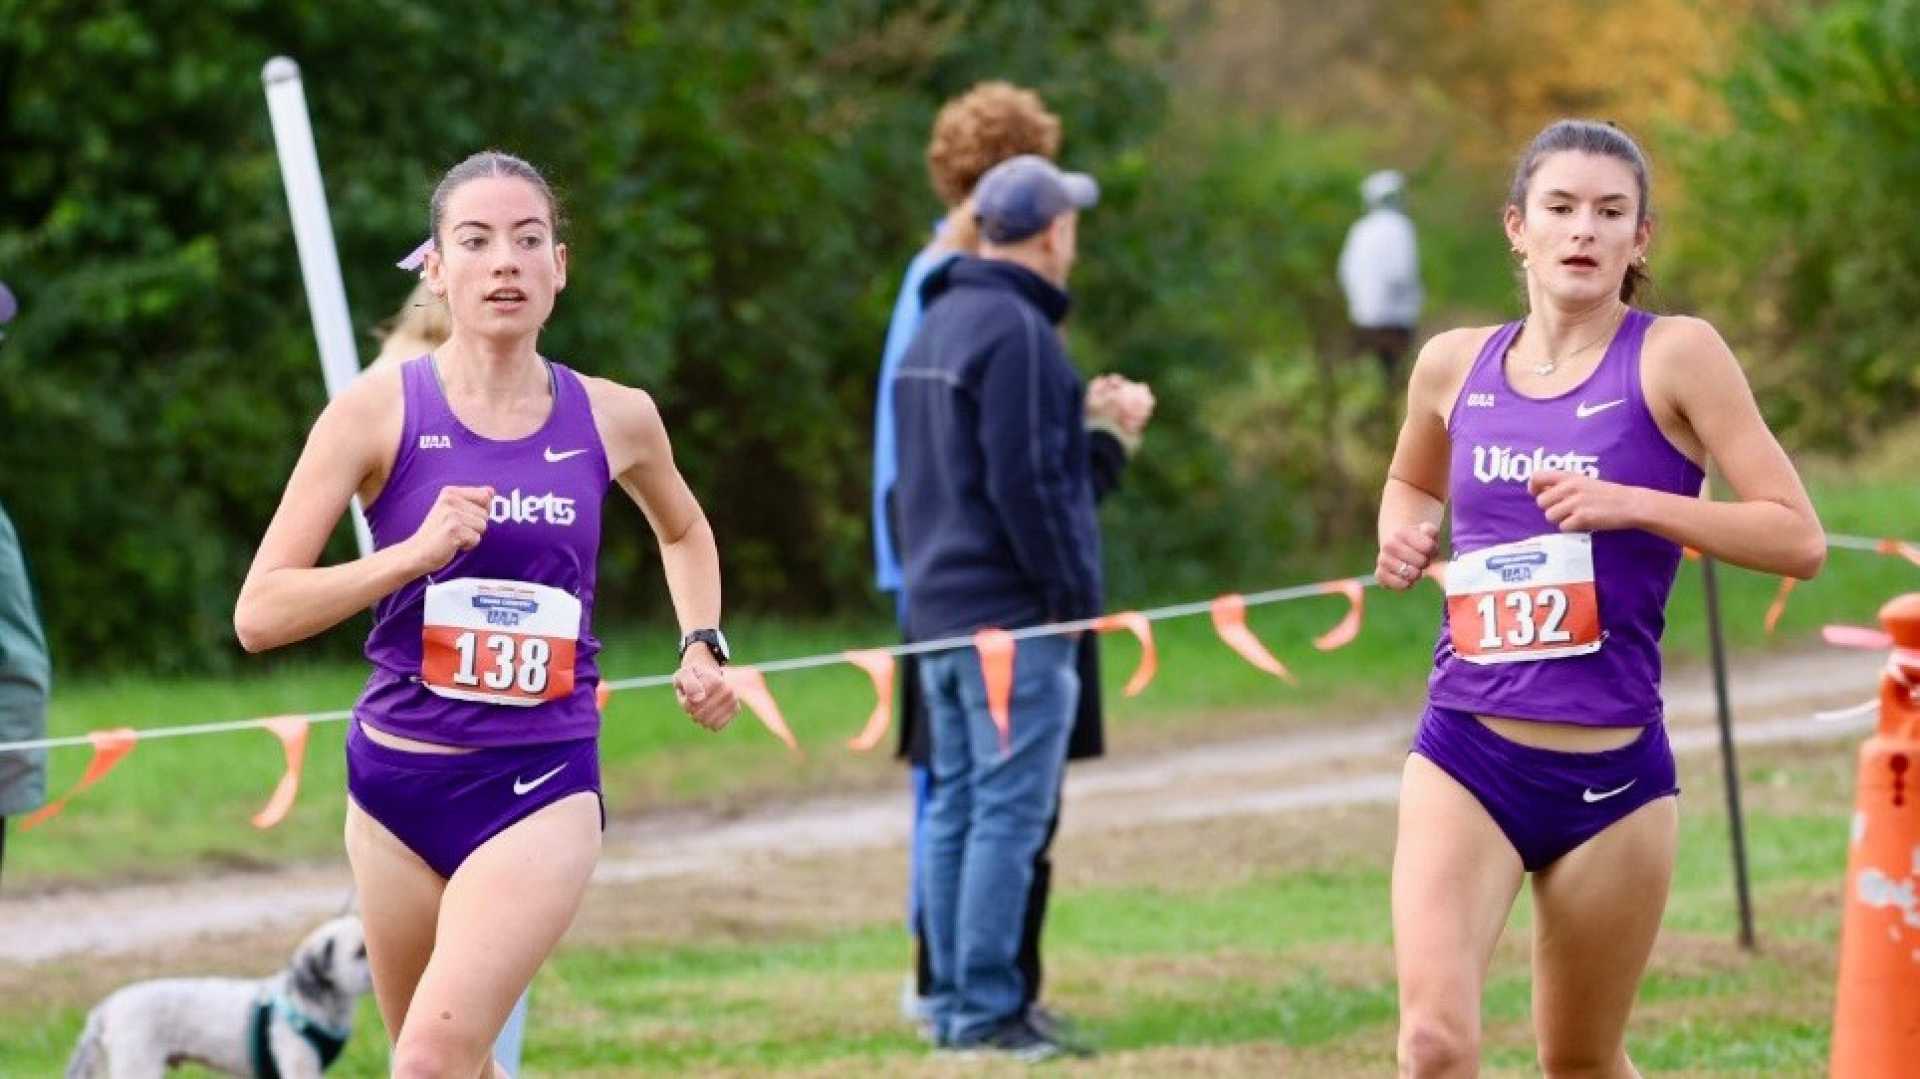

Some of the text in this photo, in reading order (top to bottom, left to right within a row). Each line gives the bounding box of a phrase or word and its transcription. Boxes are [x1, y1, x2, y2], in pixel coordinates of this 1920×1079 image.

[1473, 446, 1599, 483] Violets
[489, 488, 576, 526] olets
[1477, 588, 1571, 649] 132
[453, 632, 551, 693] 138
